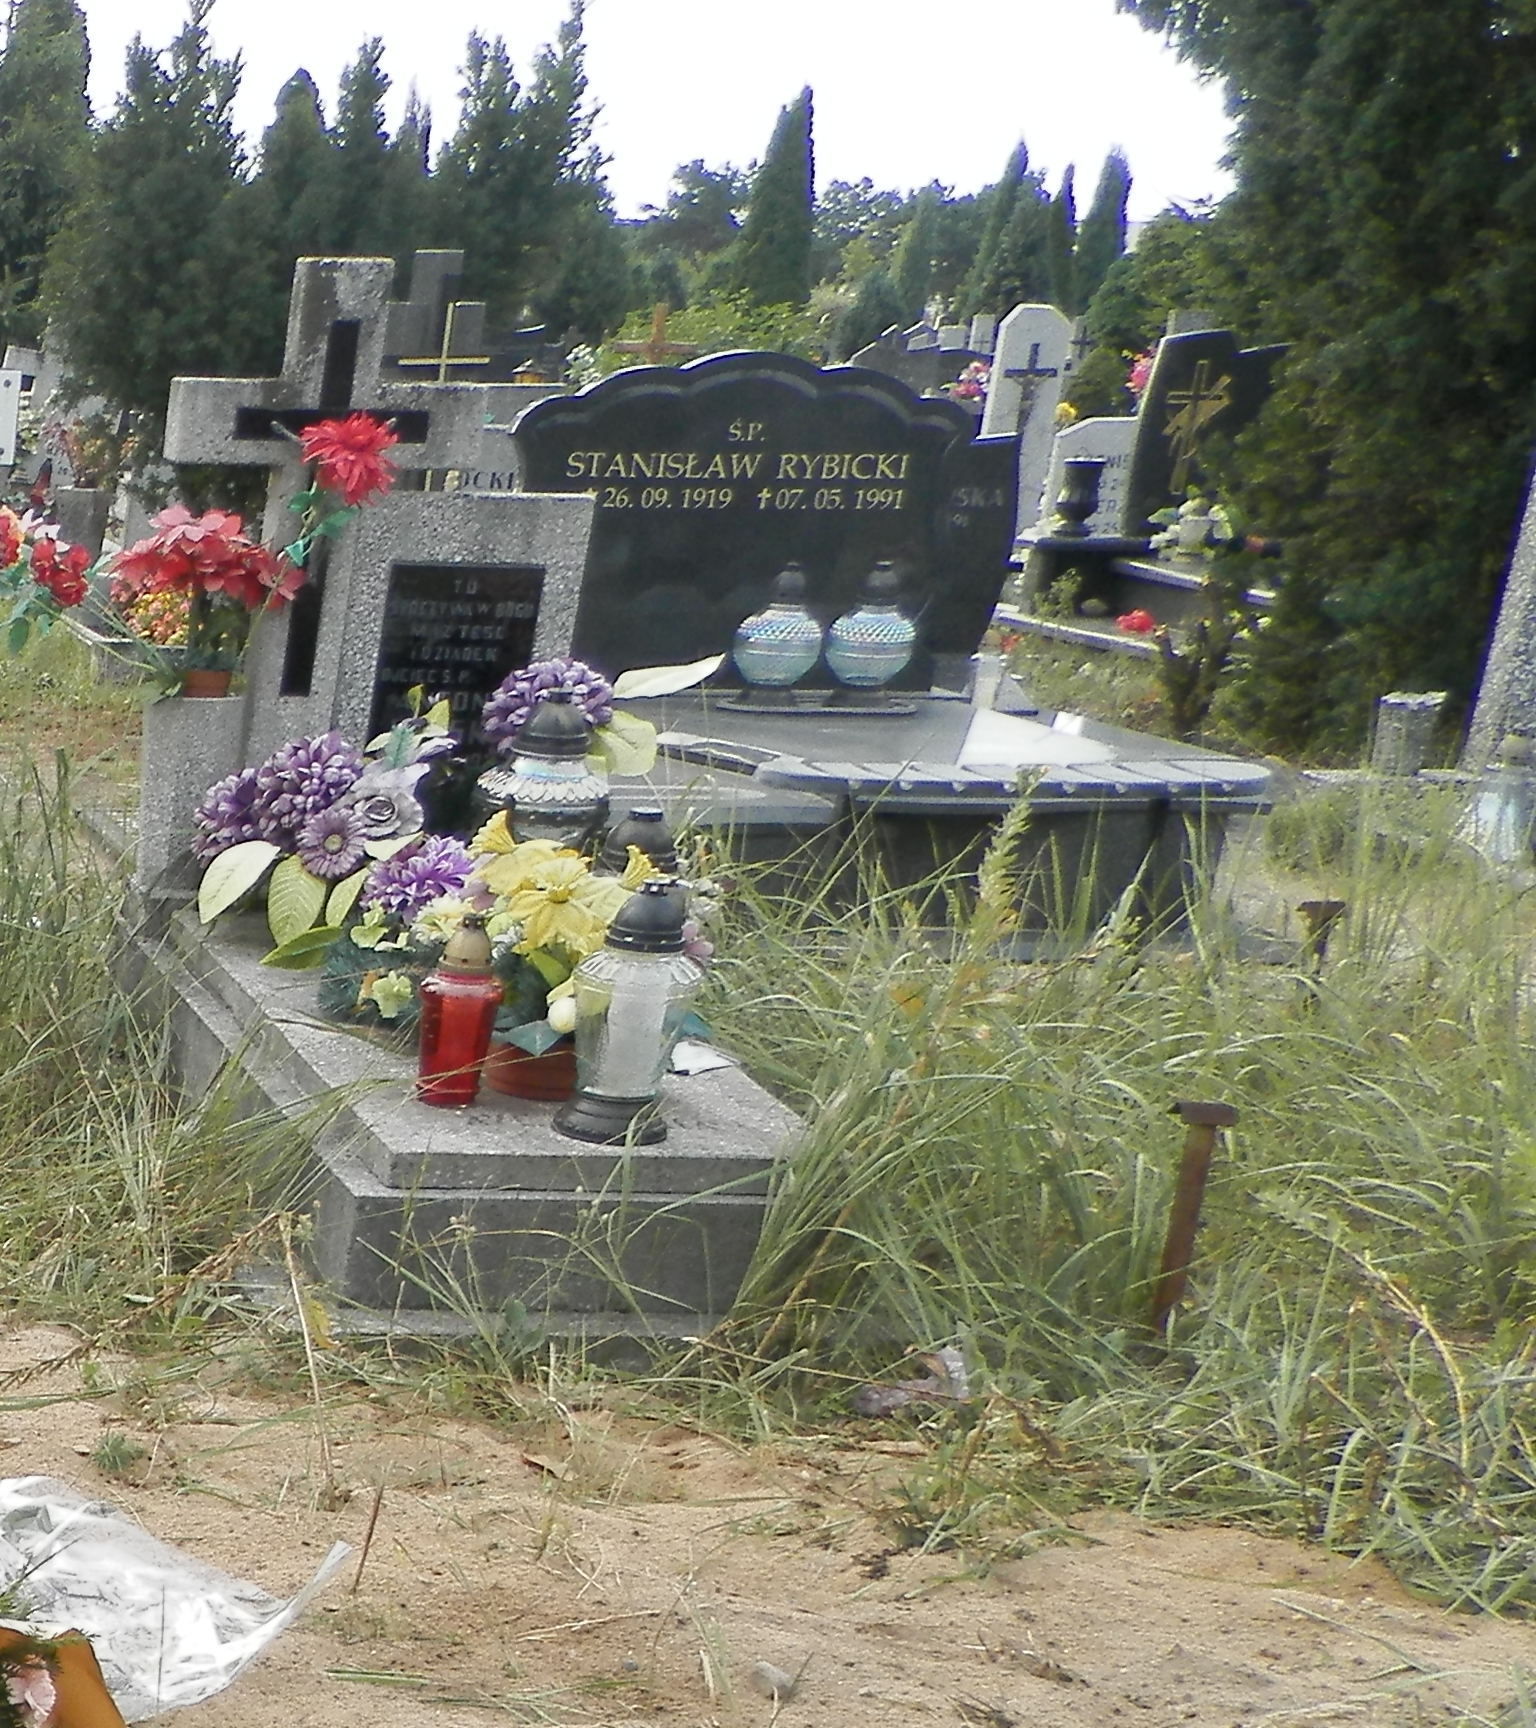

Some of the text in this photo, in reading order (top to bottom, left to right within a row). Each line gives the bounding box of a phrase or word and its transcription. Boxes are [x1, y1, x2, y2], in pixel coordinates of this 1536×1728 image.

[565, 451, 911, 480] STANISŁAW RYBICKI
[601, 487, 634, 508] 26.
[641, 487, 672, 509] 09.
[680, 488, 733, 509] 1919
[814, 488, 845, 510] 05.
[854, 488, 905, 510] 1991
